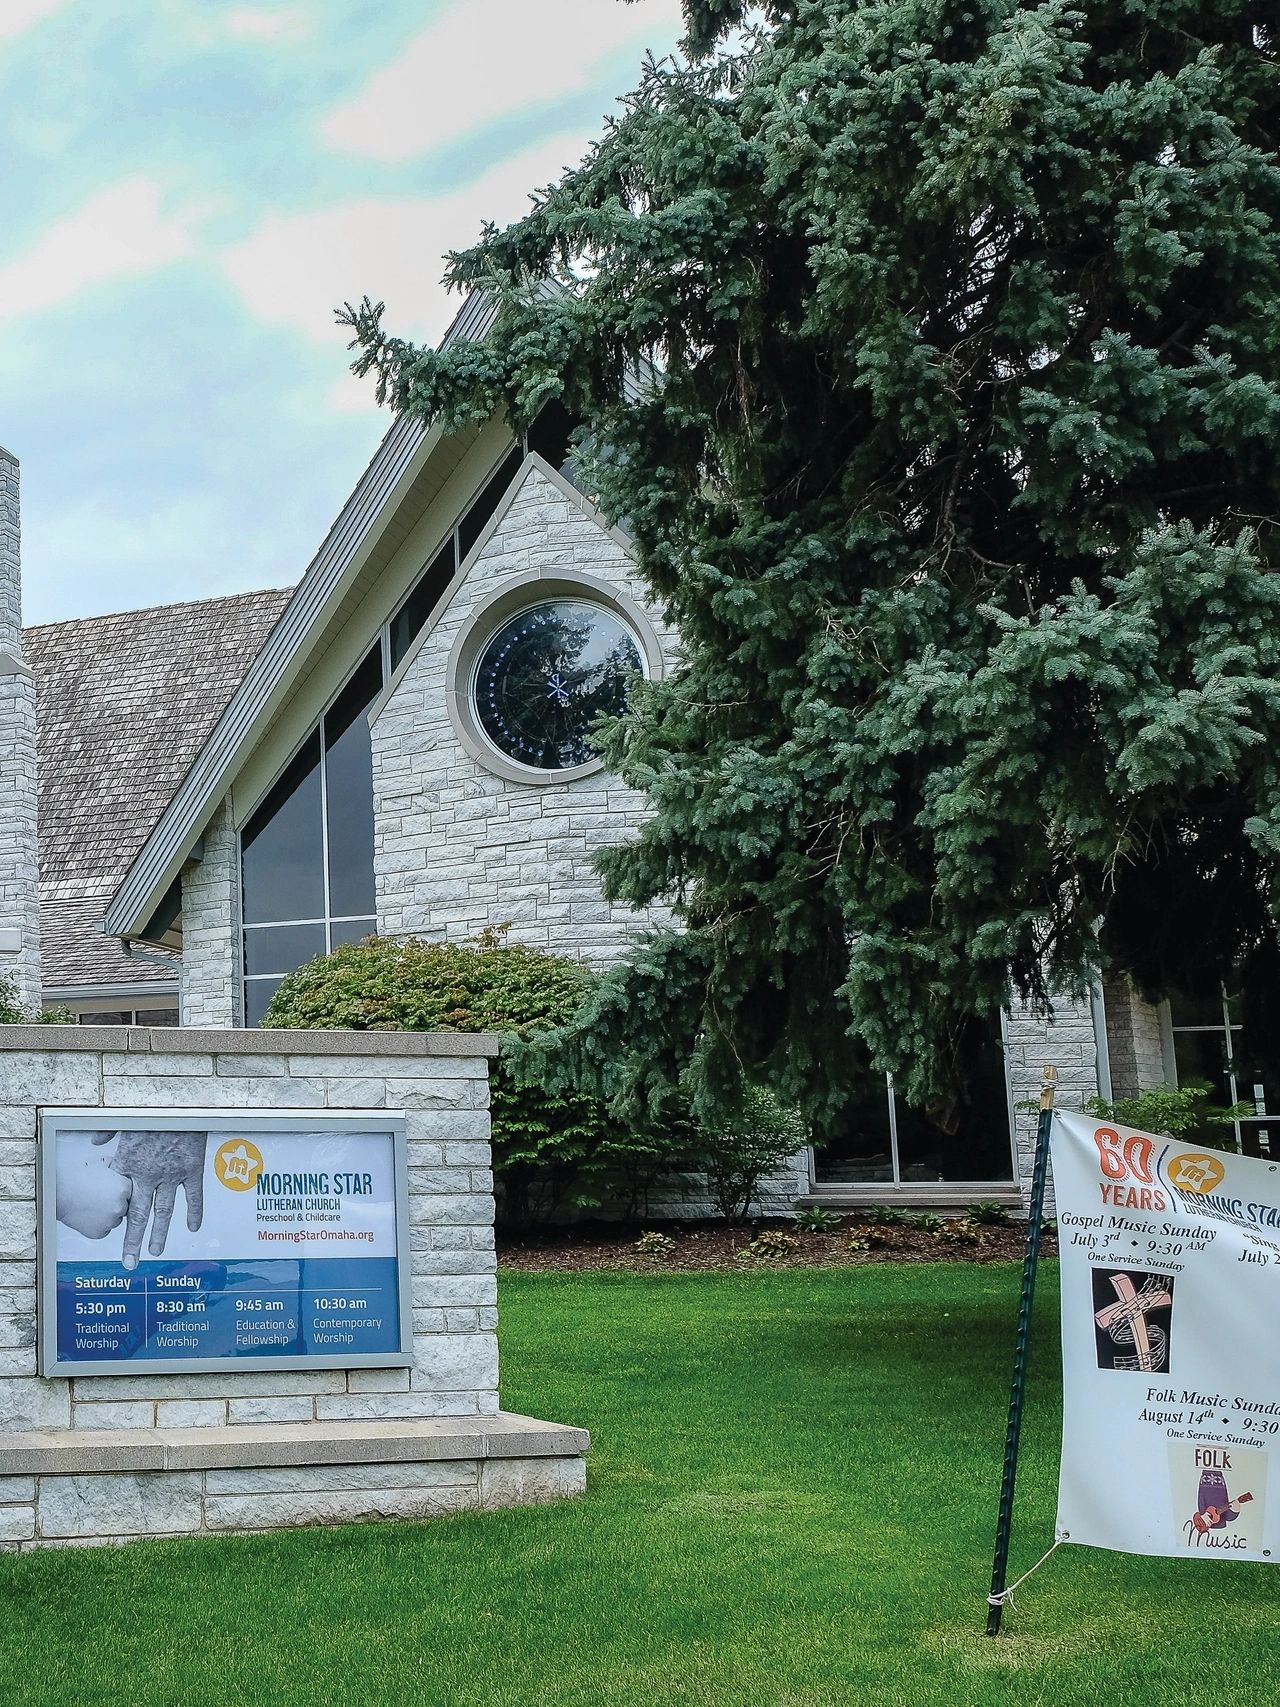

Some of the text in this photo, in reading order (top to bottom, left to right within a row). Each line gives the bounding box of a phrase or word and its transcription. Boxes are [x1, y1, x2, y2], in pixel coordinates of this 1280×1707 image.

[1093, 1127, 1155, 1185] 60
[256, 1173, 372, 1196] MORNING STAR
[256, 1198, 341, 1211] LUTHERAN CHURCH
[1098, 1182, 1166, 1213] YEARS
[1172, 1186, 1245, 1220] MORNING
[256, 1212, 341, 1222] Preschool & Childcare
[1061, 1211, 1217, 1243] Gospel Music Sunday
[258, 1229, 375, 1243] MorningStarOmaha.org
[1070, 1231, 1207, 1256] July 3rd 9:30 AM
[1087, 1251, 1185, 1273] One Service Sunday
[1238, 1249, 1269, 1267] July
[75, 1275, 131, 1290] Saturday
[156, 1275, 201, 1289] Sunday
[75, 1302, 126, 1316] 5:30 pm
[156, 1301, 206, 1313] 8:30 am
[235, 1299, 284, 1311] 9:45 am
[313, 1298, 367, 1310] 10:30 am
[75, 1322, 130, 1334] Traditional
[156, 1321, 210, 1332] Traditional
[236, 1318, 296, 1330] Education &
[313, 1318, 382, 1330] Contemporary
[75, 1337, 119, 1350] Worship
[156, 1336, 199, 1349] Worship
[236, 1333, 289, 1346] Fellowship
[313, 1332, 354, 1344] Worship
[1146, 1387, 1177, 1403] Folk
[1180, 1390, 1228, 1408] Music
[1138, 1408, 1280, 1435] August 14th 9:30
[1166, 1428, 1266, 1449] One Service Sunday
[1194, 1448, 1233, 1469] FOLK
